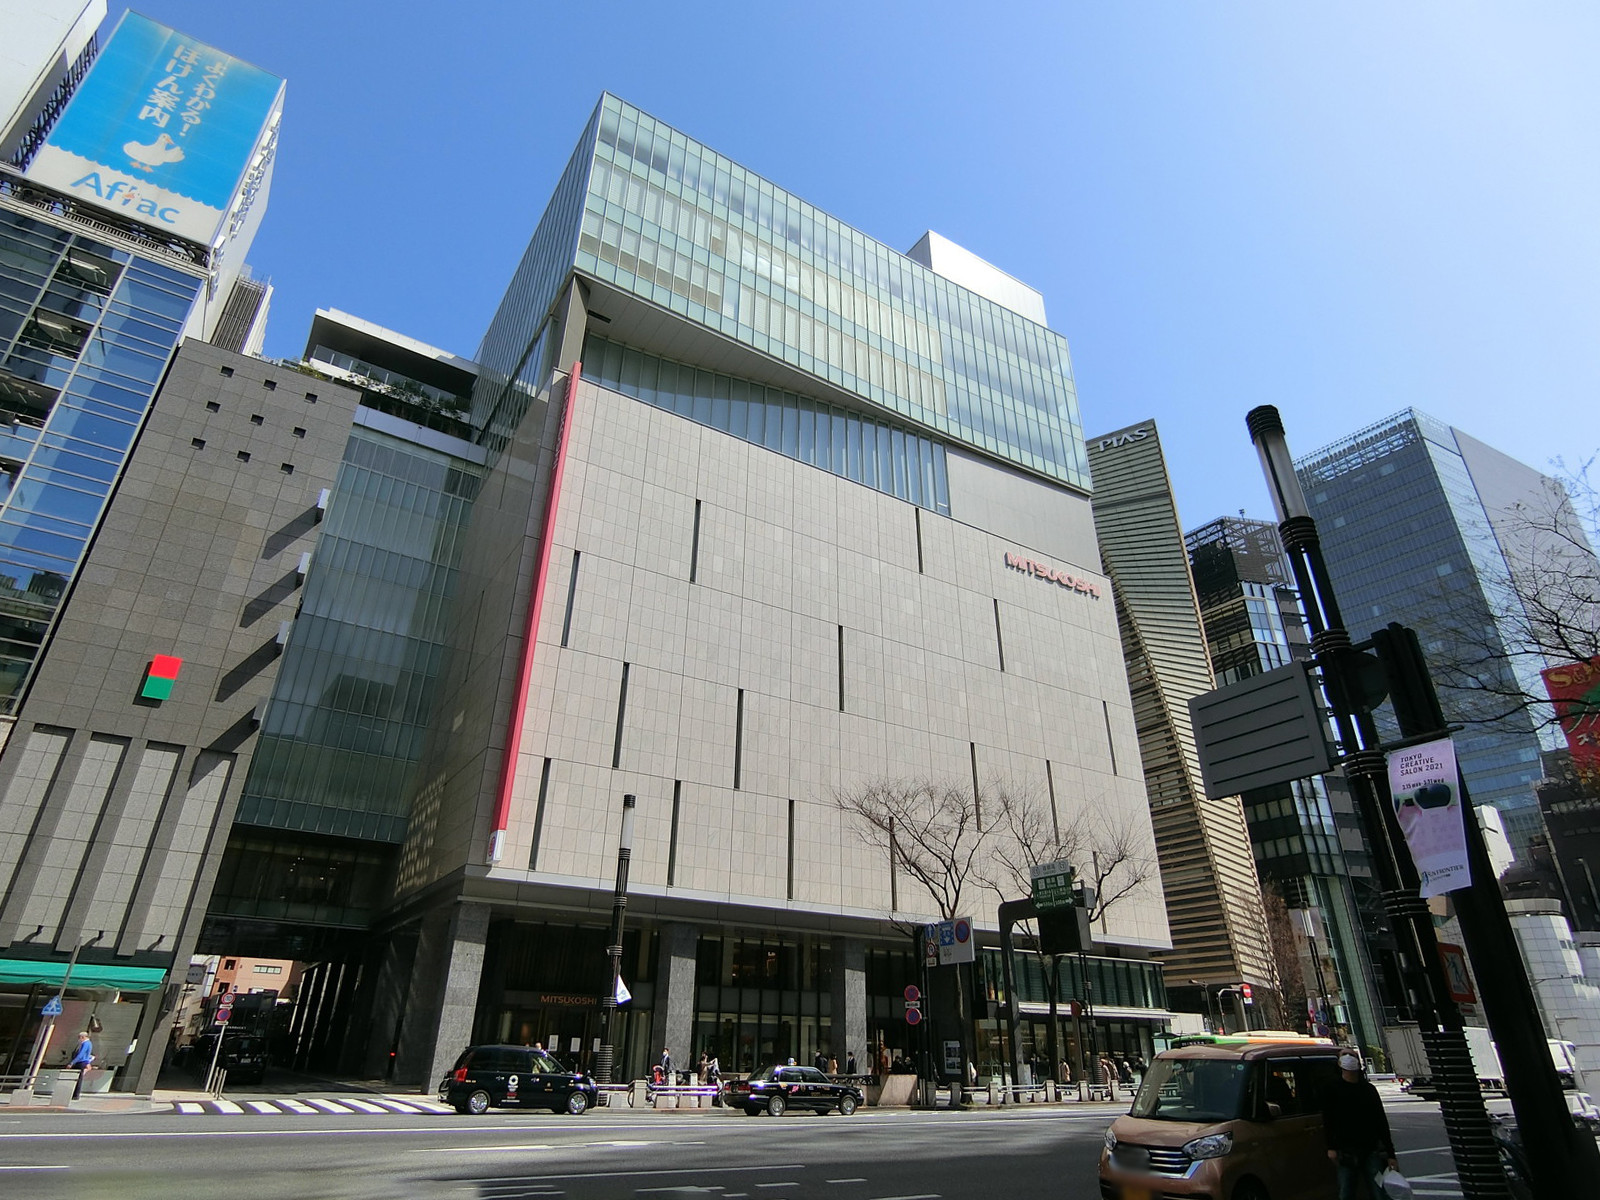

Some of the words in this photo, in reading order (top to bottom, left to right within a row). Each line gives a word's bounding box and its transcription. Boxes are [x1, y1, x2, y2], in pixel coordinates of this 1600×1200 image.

[138, 44, 201, 128] ほけん案内
[1099, 427, 1149, 452] PIAS
[1005, 552, 1102, 599] MITSUKOSHI
[1400, 753, 1422, 763] TOKYO
[1400, 757, 1434, 770] CREATIVE
[1400, 766, 1423, 777] SALON
[1425, 763, 1443, 771] 2021
[541, 995, 597, 1005] MITSUKOSHI
